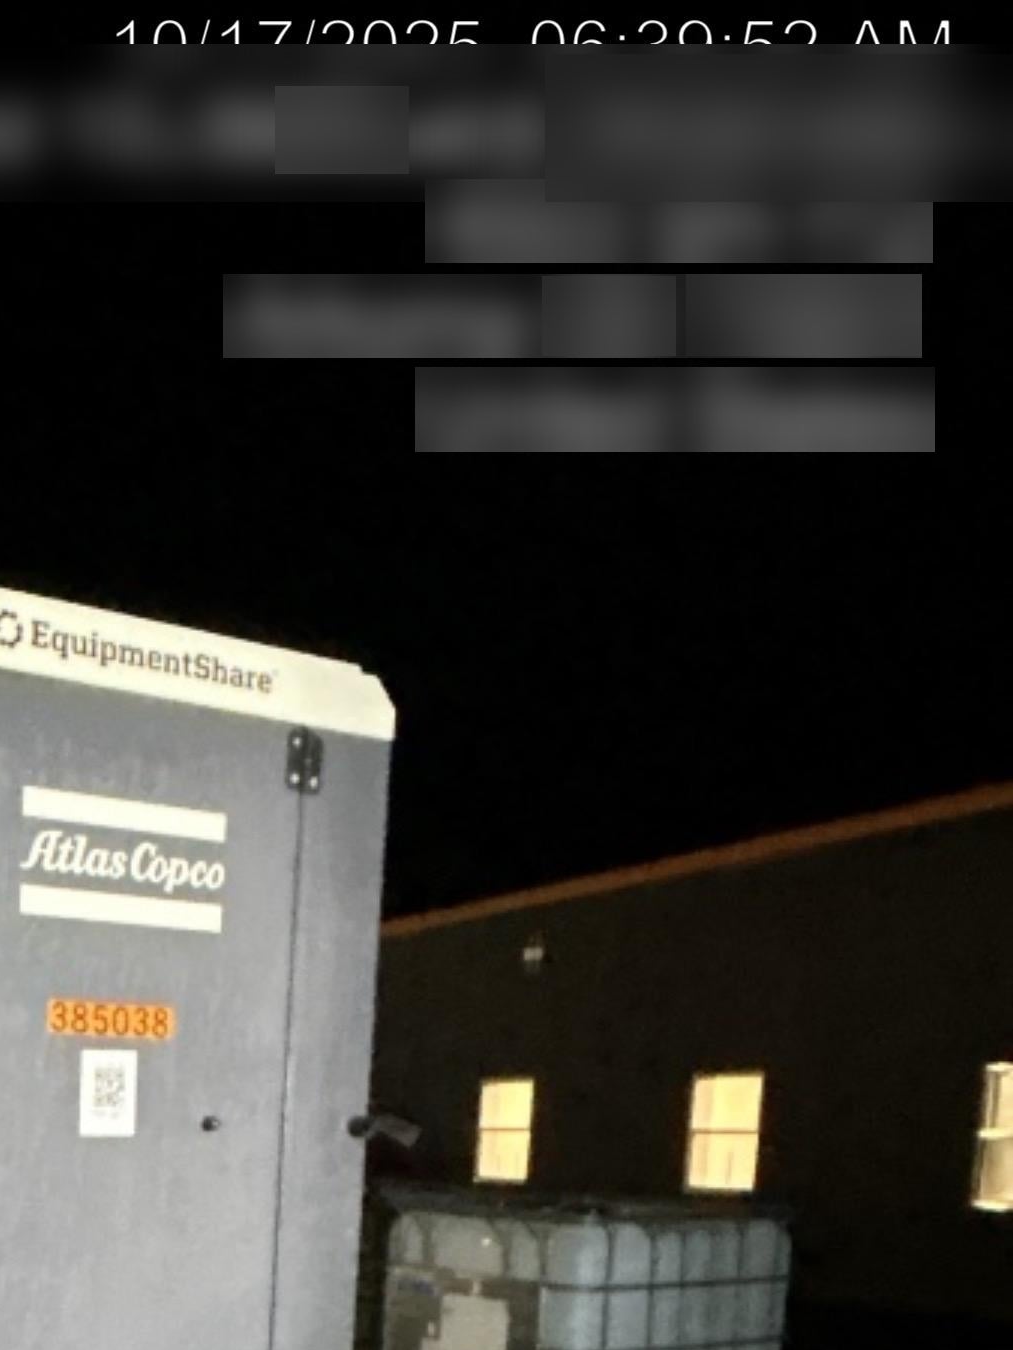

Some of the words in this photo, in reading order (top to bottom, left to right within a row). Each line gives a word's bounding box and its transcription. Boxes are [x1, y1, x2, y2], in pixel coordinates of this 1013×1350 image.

[31, 619, 273, 693] EquipmentShare
[19, 829, 129, 879] Atlas
[130, 841, 226, 894] Copco
[50, 1001, 169, 1039] 385038
